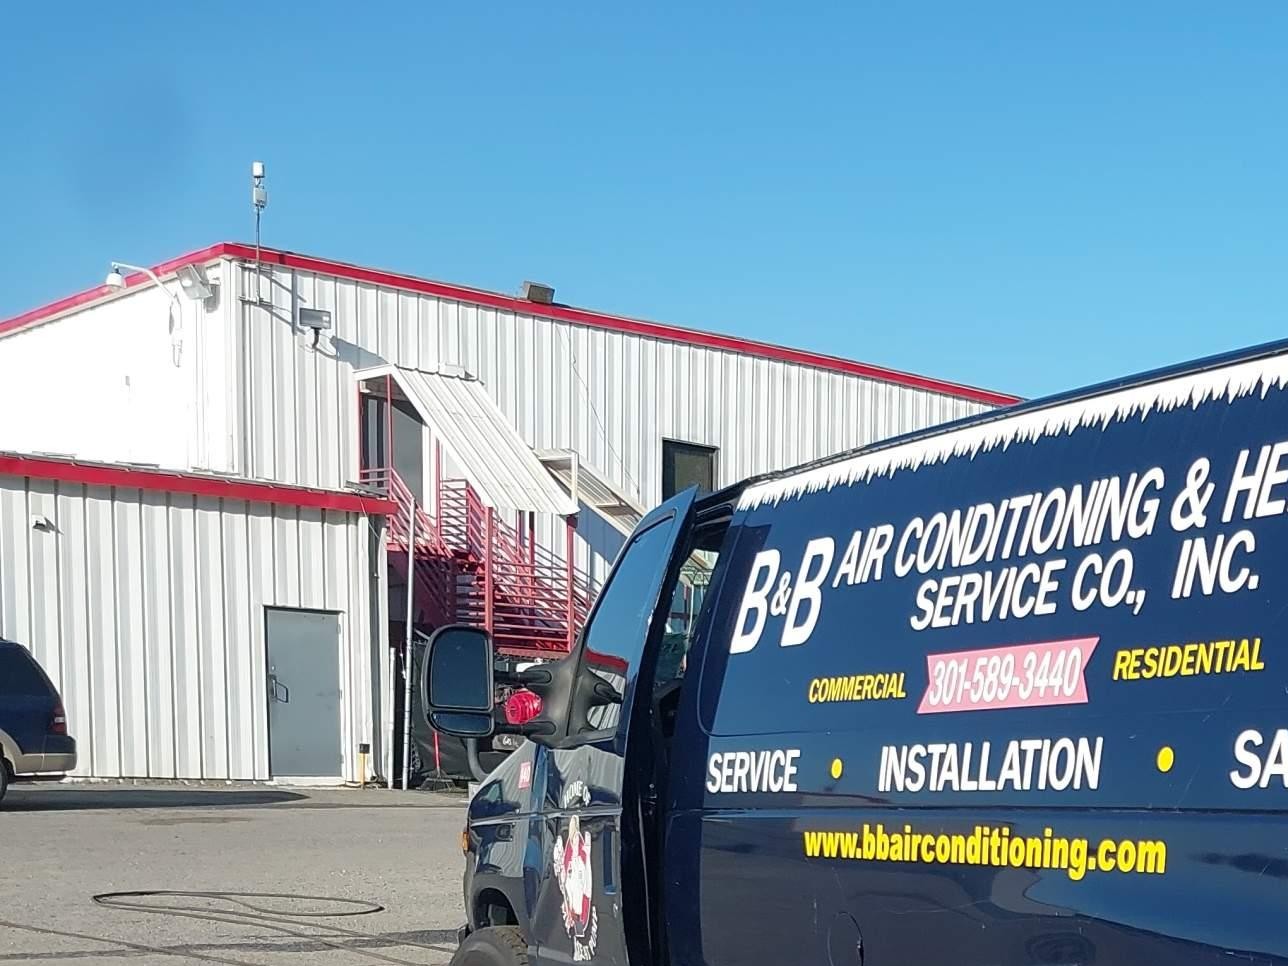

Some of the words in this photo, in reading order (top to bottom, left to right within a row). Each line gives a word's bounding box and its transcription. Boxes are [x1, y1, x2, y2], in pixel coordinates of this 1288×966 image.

[730, 537, 837, 654] B&B
[833, 522, 895, 590] AIR
[895, 470, 1166, 578] CONDITIONING
[1170, 458, 1215, 532] &
[910, 558, 1058, 631] SERVICE
[1071, 548, 1145, 617] CO.,
[1172, 530, 1260, 600] INC.
[928, 645, 1083, 708] 301-589-3440
[1112, 637, 1265, 681] RESIDENTIAL
[808, 672, 907, 703] COMMERCIAL
[706, 748, 801, 794] SERVICE
[877, 736, 1103, 793] INSTALLATION
[803, 826, 1167, 881] www.bbairconditioning.com
